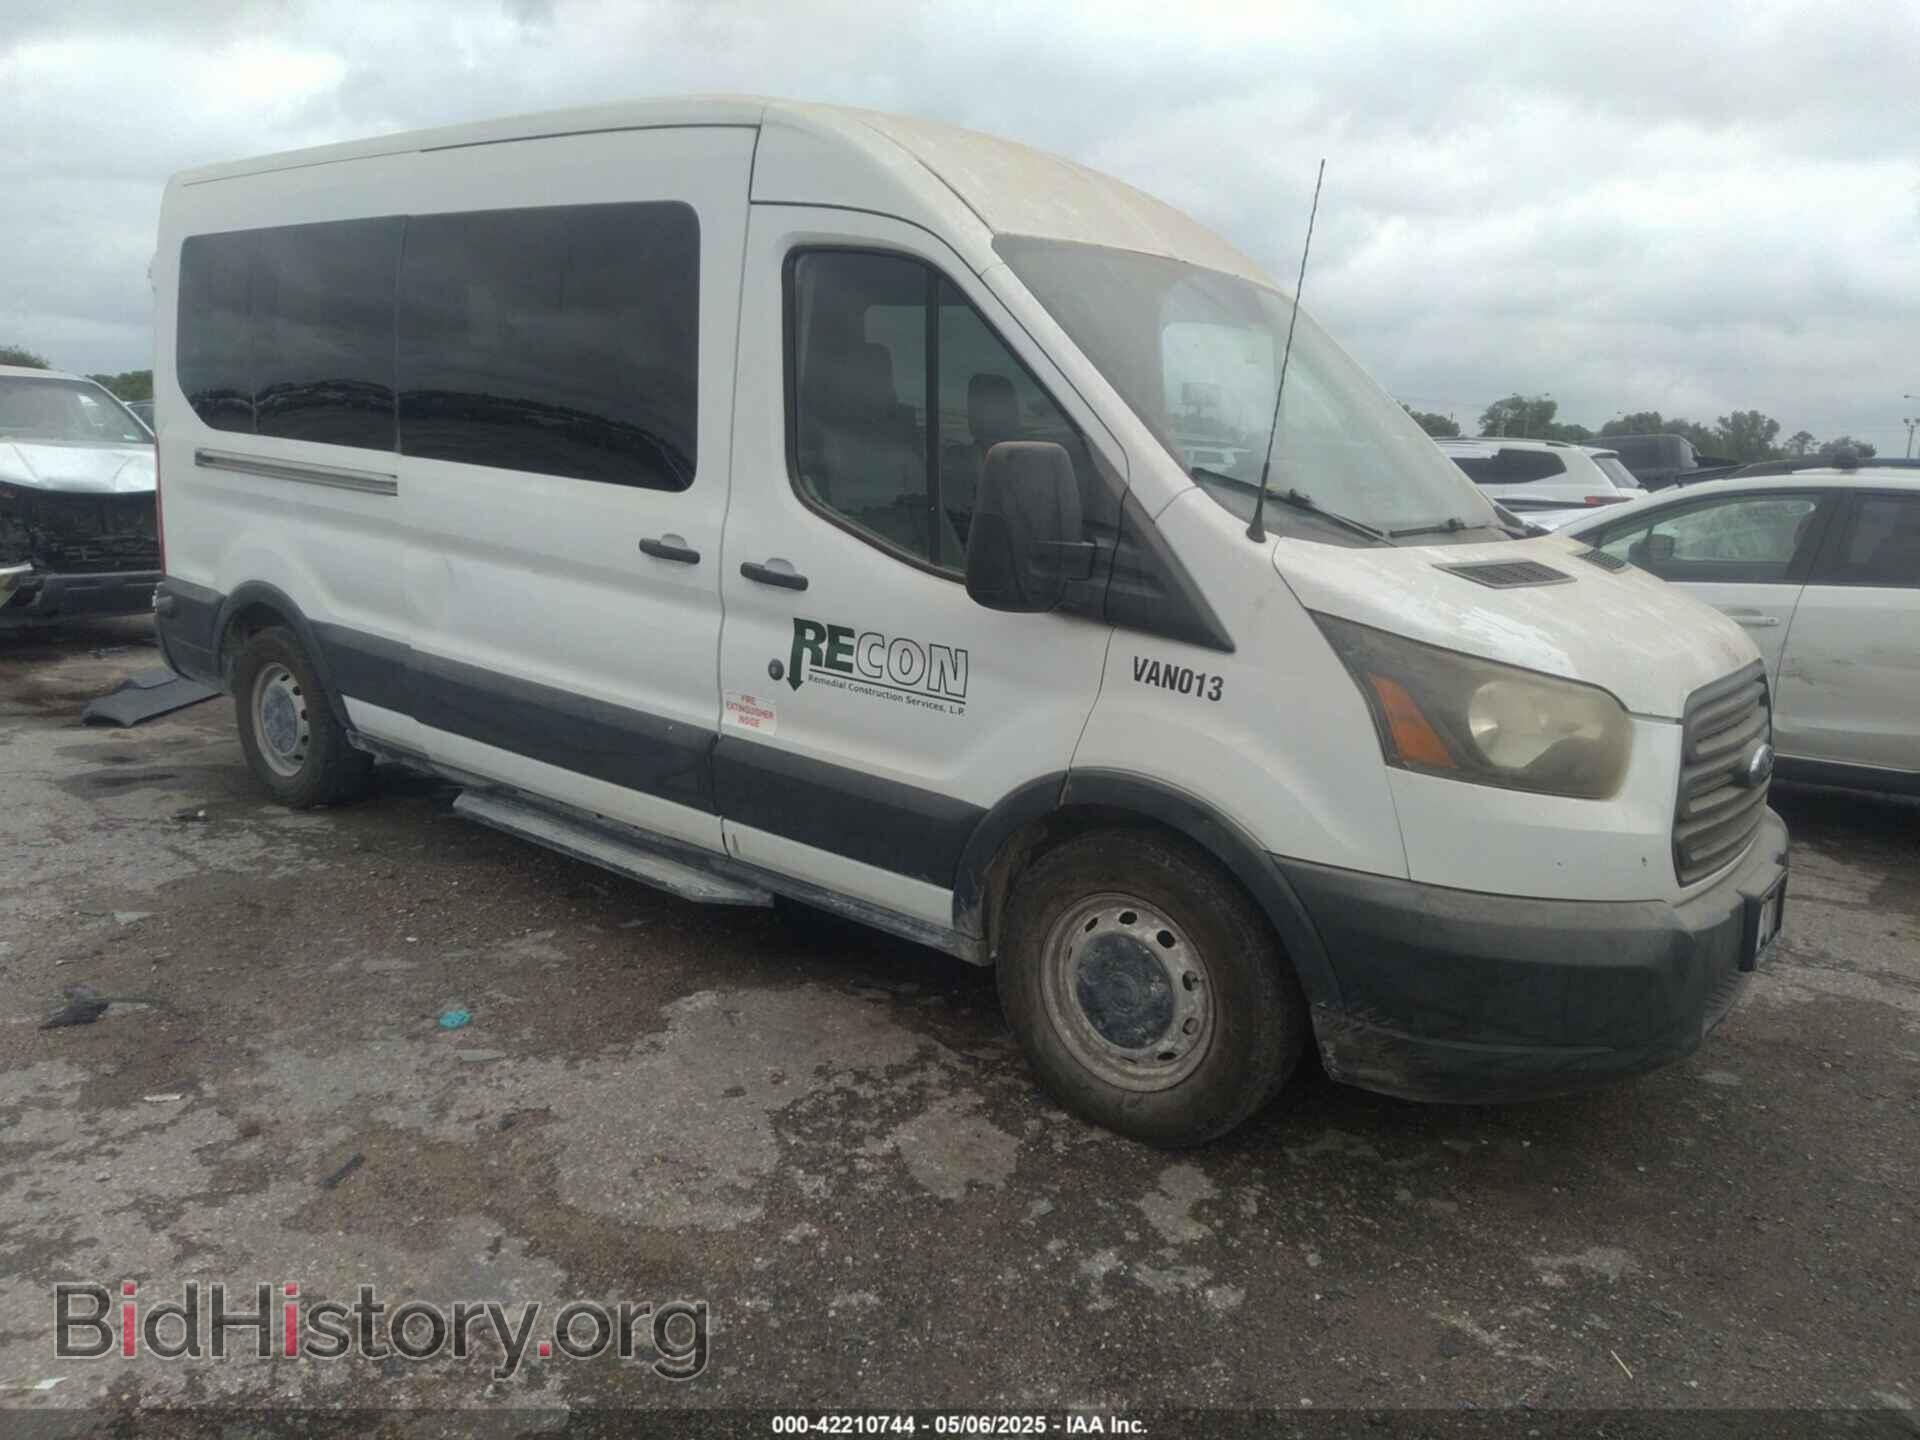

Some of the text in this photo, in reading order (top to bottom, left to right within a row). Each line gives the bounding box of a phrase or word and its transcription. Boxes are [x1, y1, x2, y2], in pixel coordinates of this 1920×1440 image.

[787, 618, 968, 698] RECON
[1133, 656, 1224, 702] VAN013
[808, 674, 847, 689] Remedial
[848, 683, 903, 702] Construction
[906, 696, 947, 713] Services,
